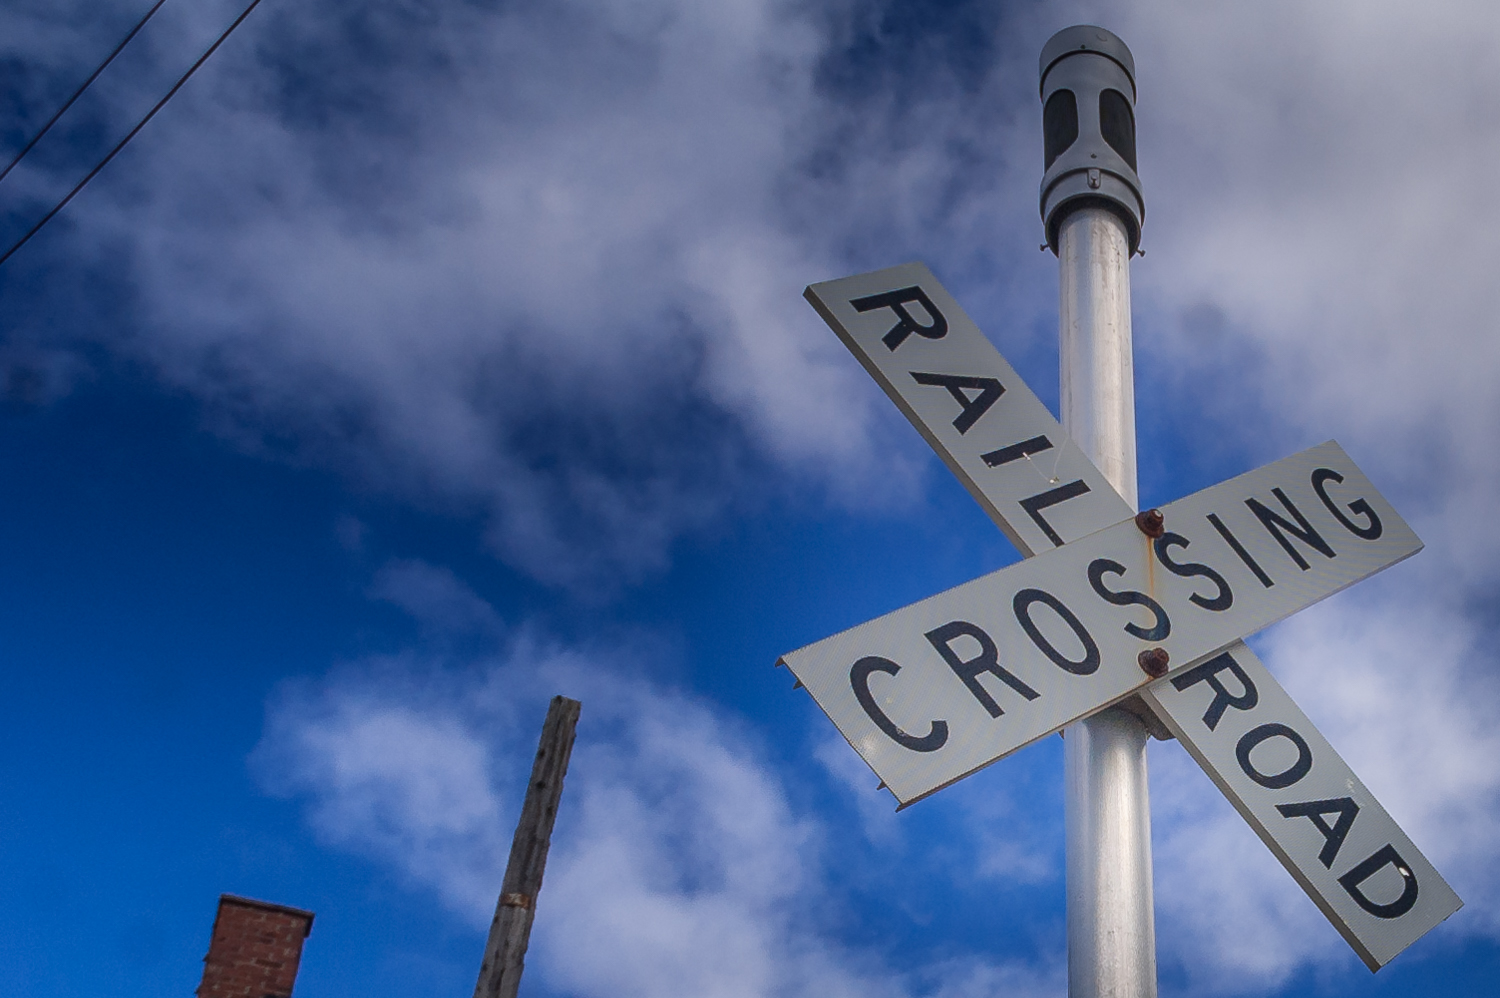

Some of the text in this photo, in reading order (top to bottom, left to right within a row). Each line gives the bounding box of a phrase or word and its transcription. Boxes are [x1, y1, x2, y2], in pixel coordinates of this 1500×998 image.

[849, 285, 1419, 920] RAIL ROAD
[849, 468, 1383, 753] CROSSING
